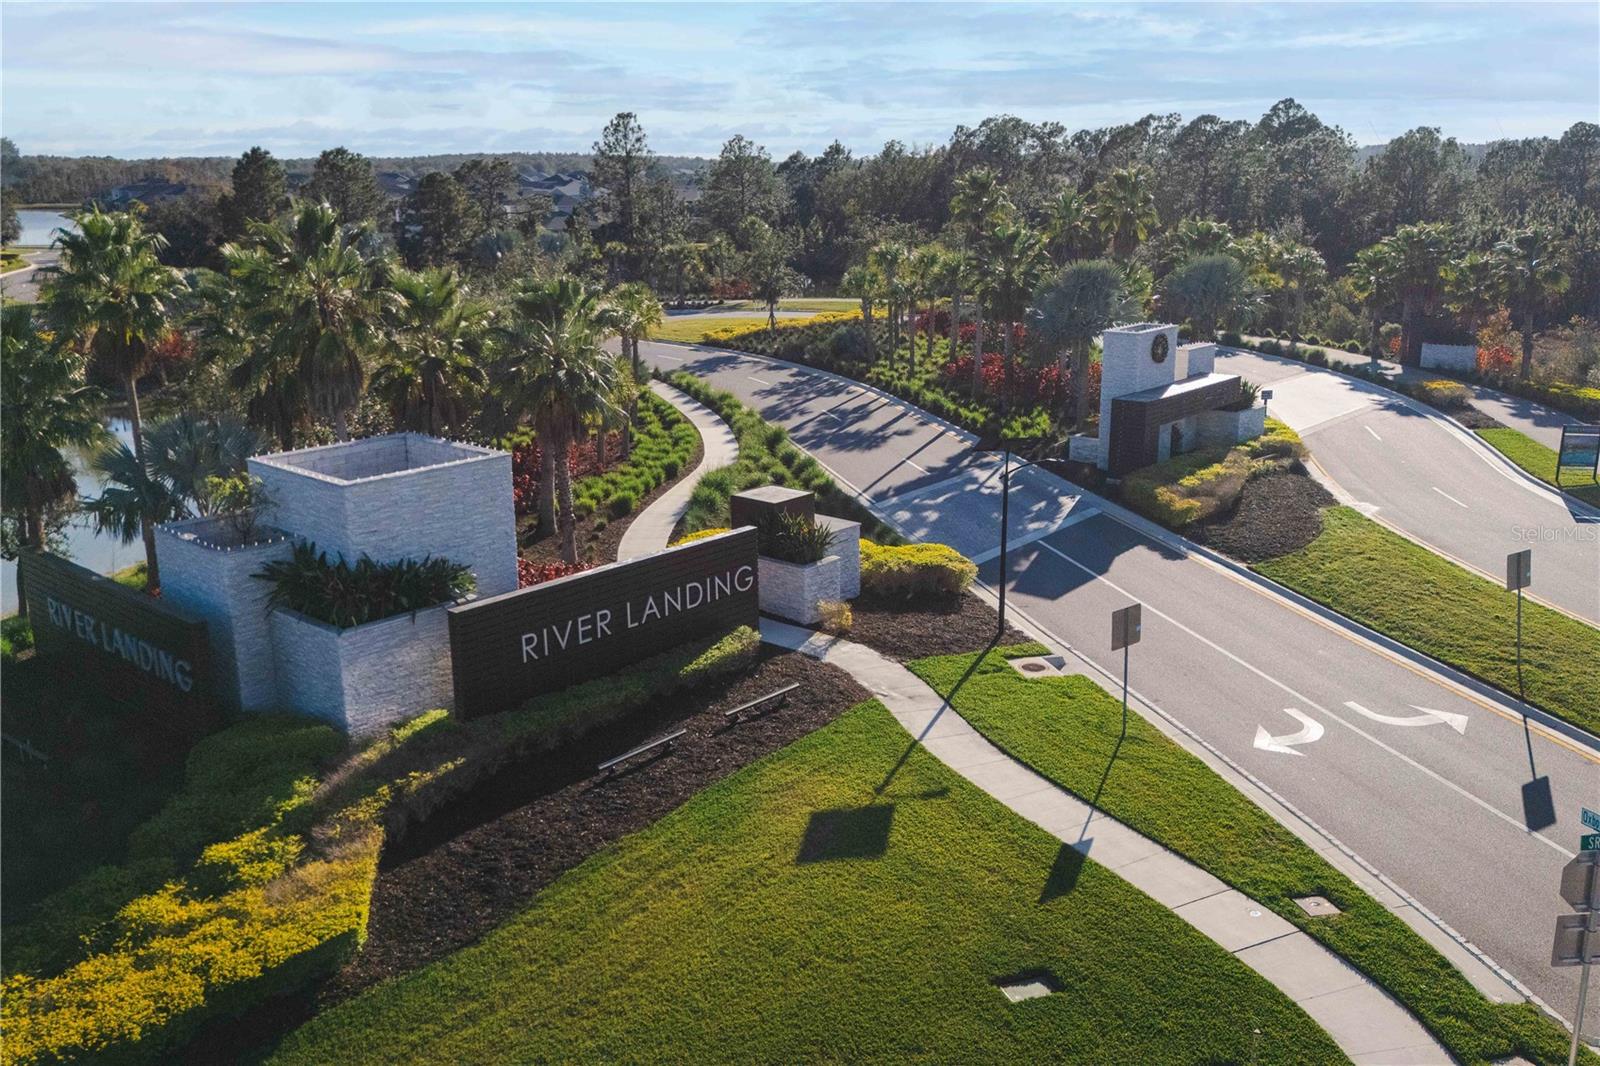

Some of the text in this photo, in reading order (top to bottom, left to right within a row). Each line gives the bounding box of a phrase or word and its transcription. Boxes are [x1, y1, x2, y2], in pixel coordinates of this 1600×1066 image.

[47, 598, 193, 692] RIVER LANDING
[521, 565, 754, 663] RIVER LANDING
